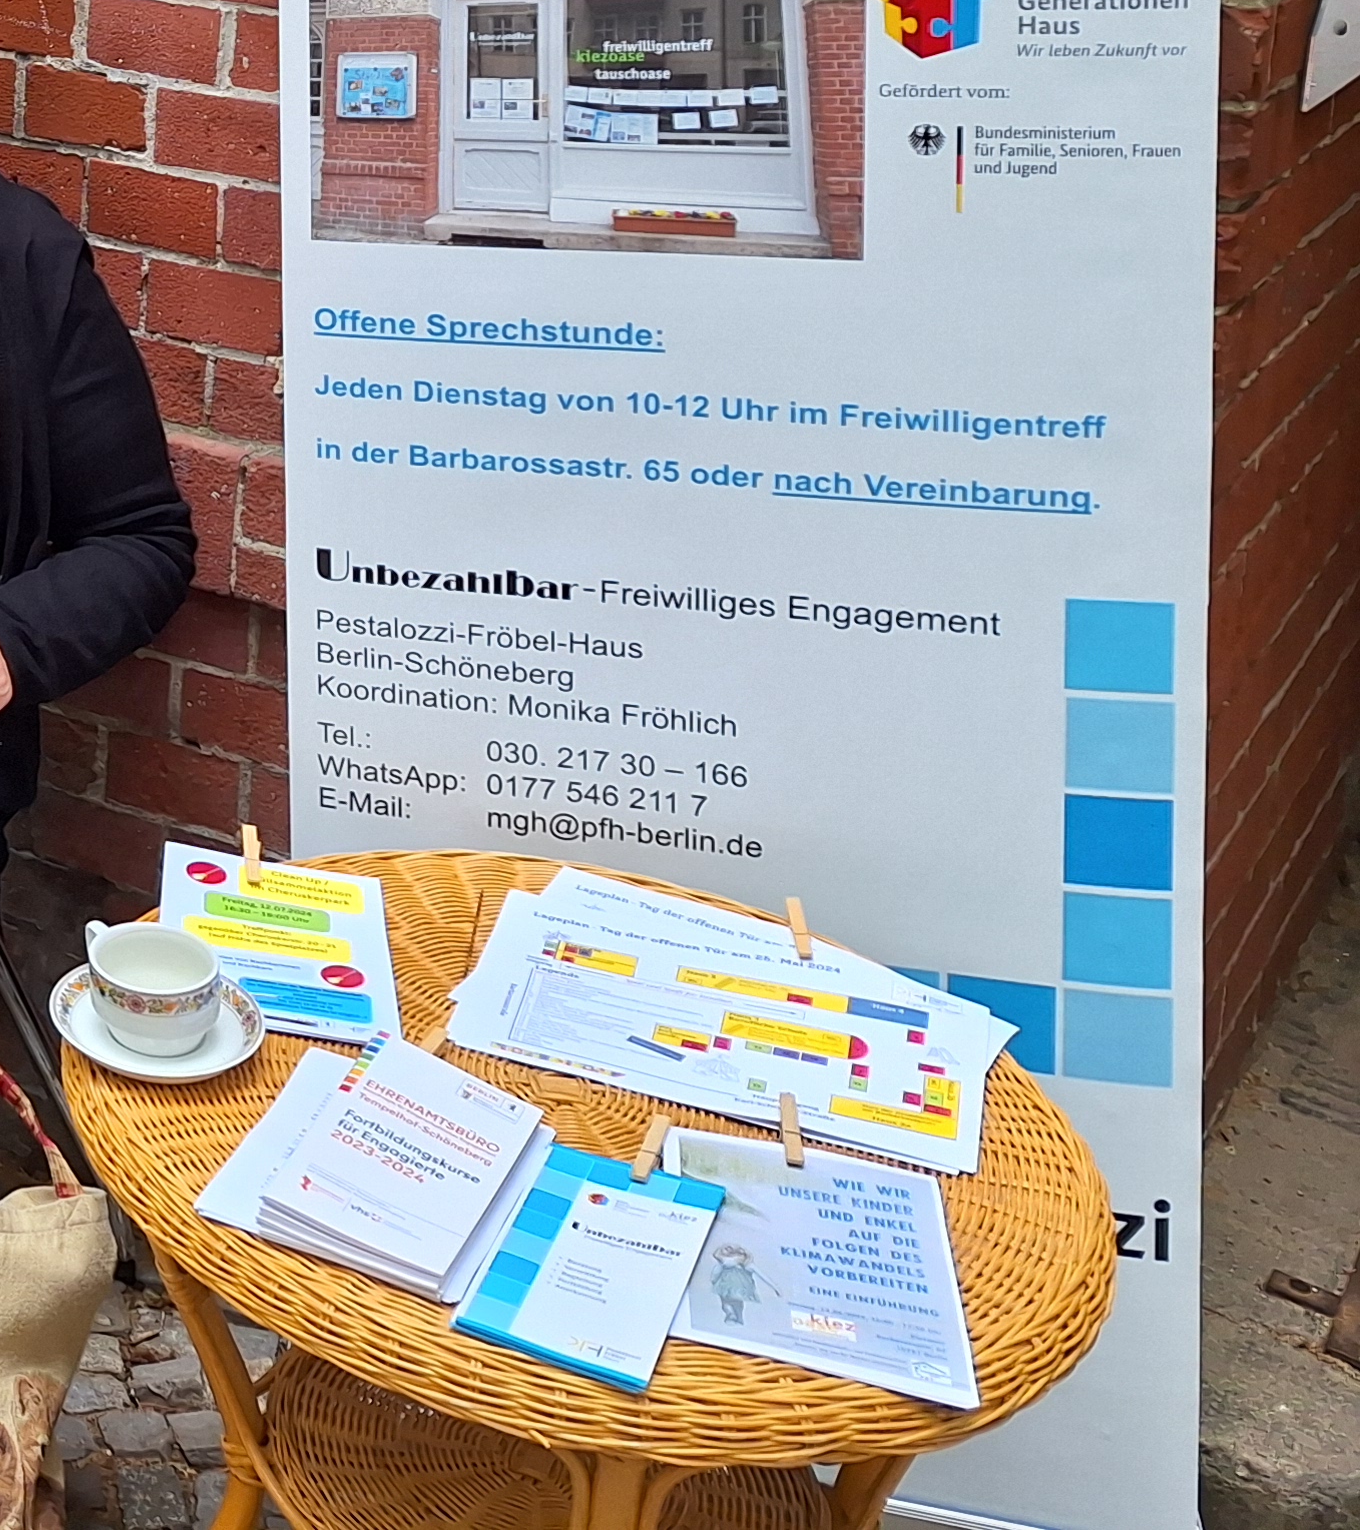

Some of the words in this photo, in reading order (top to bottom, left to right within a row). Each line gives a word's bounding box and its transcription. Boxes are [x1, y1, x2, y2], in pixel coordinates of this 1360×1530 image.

[1018, 15, 1081, 35] Haus
[575, 49, 645, 63] kiezoase
[602, 38, 714, 55] freiwilligentreff
[1016, 43, 1045, 57] Wir
[1048, 43, 1091, 57] leben
[1092, 42, 1158, 60] Zukunft
[1162, 46, 1188, 56] vor
[594, 68, 671, 81] tauschoase
[879, 83, 963, 99] Gefördert
[965, 88, 1010, 99] vom:
[975, 125, 1116, 140] Bundesministerium
[974, 142, 995, 157] für
[999, 142, 1056, 160] Familie,
[1059, 143, 1128, 160] Senioren,
[1132, 143, 1182, 158] Frauen
[974, 160, 1002, 175] und
[1005, 160, 1058, 179] Jugend
[314, 307, 416, 336] Offene
[420, 313, 666, 354] Sprechstunde:
[314, 374, 402, 401] Jeden
[413, 380, 547, 415] Dienstag
[557, 393, 614, 413] von
[626, 392, 710, 419] 10-12
[721, 396, 780, 422] Uhr
[790, 400, 828, 426] im
[840, 403, 1107, 441] Freiwilligentreff
[317, 437, 341, 461] in
[351, 441, 400, 465] der
[409, 444, 632, 480] Barbarossastr.
[643, 459, 680, 483] 65
[690, 464, 764, 489] oder
[771, 471, 858, 502] nach
[858, 473, 1100, 516] Vereinbarung.
[789, 595, 1001, 637] Engagement
[316, 609, 644, 659] Pestalozzi-Fröbel-Haus
[317, 641, 574, 693] Berlin-Schöneberg
[317, 674, 497, 714] Koordination:
[508, 693, 610, 724] Monika
[622, 703, 737, 738] Fröhlich
[316, 721, 371, 749] Tel.:
[317, 753, 466, 796] WhatsApp:
[319, 786, 411, 819] E-Mail:
[487, 810, 763, 858] mgh@pfh-berlin.de
[533, 910, 590, 929] Lageplan
[600, 923, 622, 940] Tag
[625, 930, 645, 942] der
[650, 934, 700, 952] offenen
[705, 943, 727, 957] Tür
[732, 950, 751, 960] am
[754, 951, 775, 964] 25.
[781, 957, 804, 968] Mai
[807, 962, 841, 974] 2024
[358, 1091, 493, 1168] Tempelhof-Schöneberg
[366, 1078, 501, 1154] EHRENAMTSBÜRO
[331, 1129, 425, 1184] 2023-2024
[337, 1118, 359, 1135] für
[360, 1129, 446, 1182] Engagierte
[344, 1108, 481, 1185] Fortbildungskurse
[778, 1185, 842, 1205] UNSERE
[851, 1196, 914, 1217] KINDER
[832, 1176, 866, 1193] WIE
[875, 1184, 911, 1200] WIR
[817, 1208, 854, 1223] UND
[864, 1215, 917, 1233] ENKEL
[811, 1237, 880, 1257] FOLGEN
[890, 1250, 923, 1264] DES
[848, 1228, 881, 1243] AUF
[892, 1235, 921, 1249] DIE
[780, 1246, 926, 1279] KLIMAWANDELS
[807, 1264, 929, 1295] VORBEREITEN
[809, 1285, 840, 1299] EINE
[845, 1292, 940, 1318] EINFÜHRUNG
